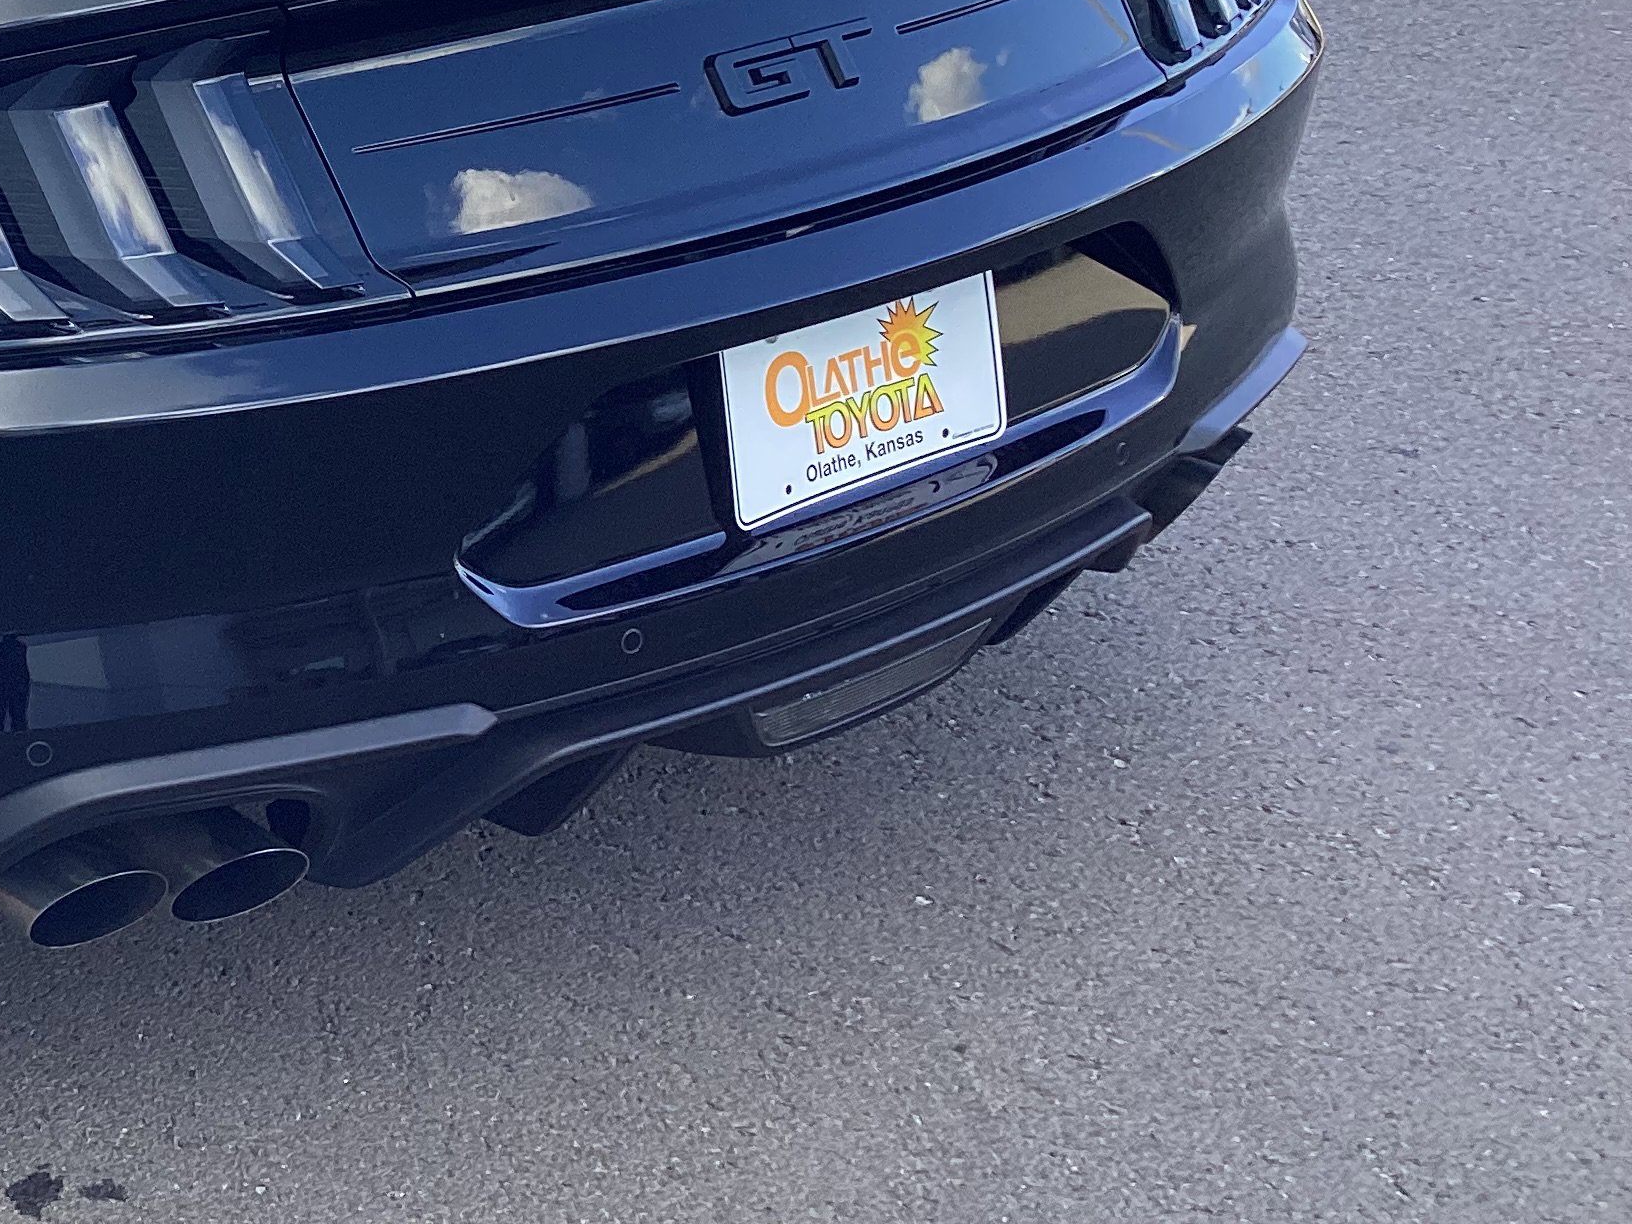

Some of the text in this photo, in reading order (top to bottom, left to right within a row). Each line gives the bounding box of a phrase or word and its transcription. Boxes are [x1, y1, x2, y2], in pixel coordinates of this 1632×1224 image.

[704, 17, 872, 117] GT
[805, 373, 944, 455] TOYOTA
[806, 454, 862, 482] Olathe,
[865, 429, 924, 461] Kansas
